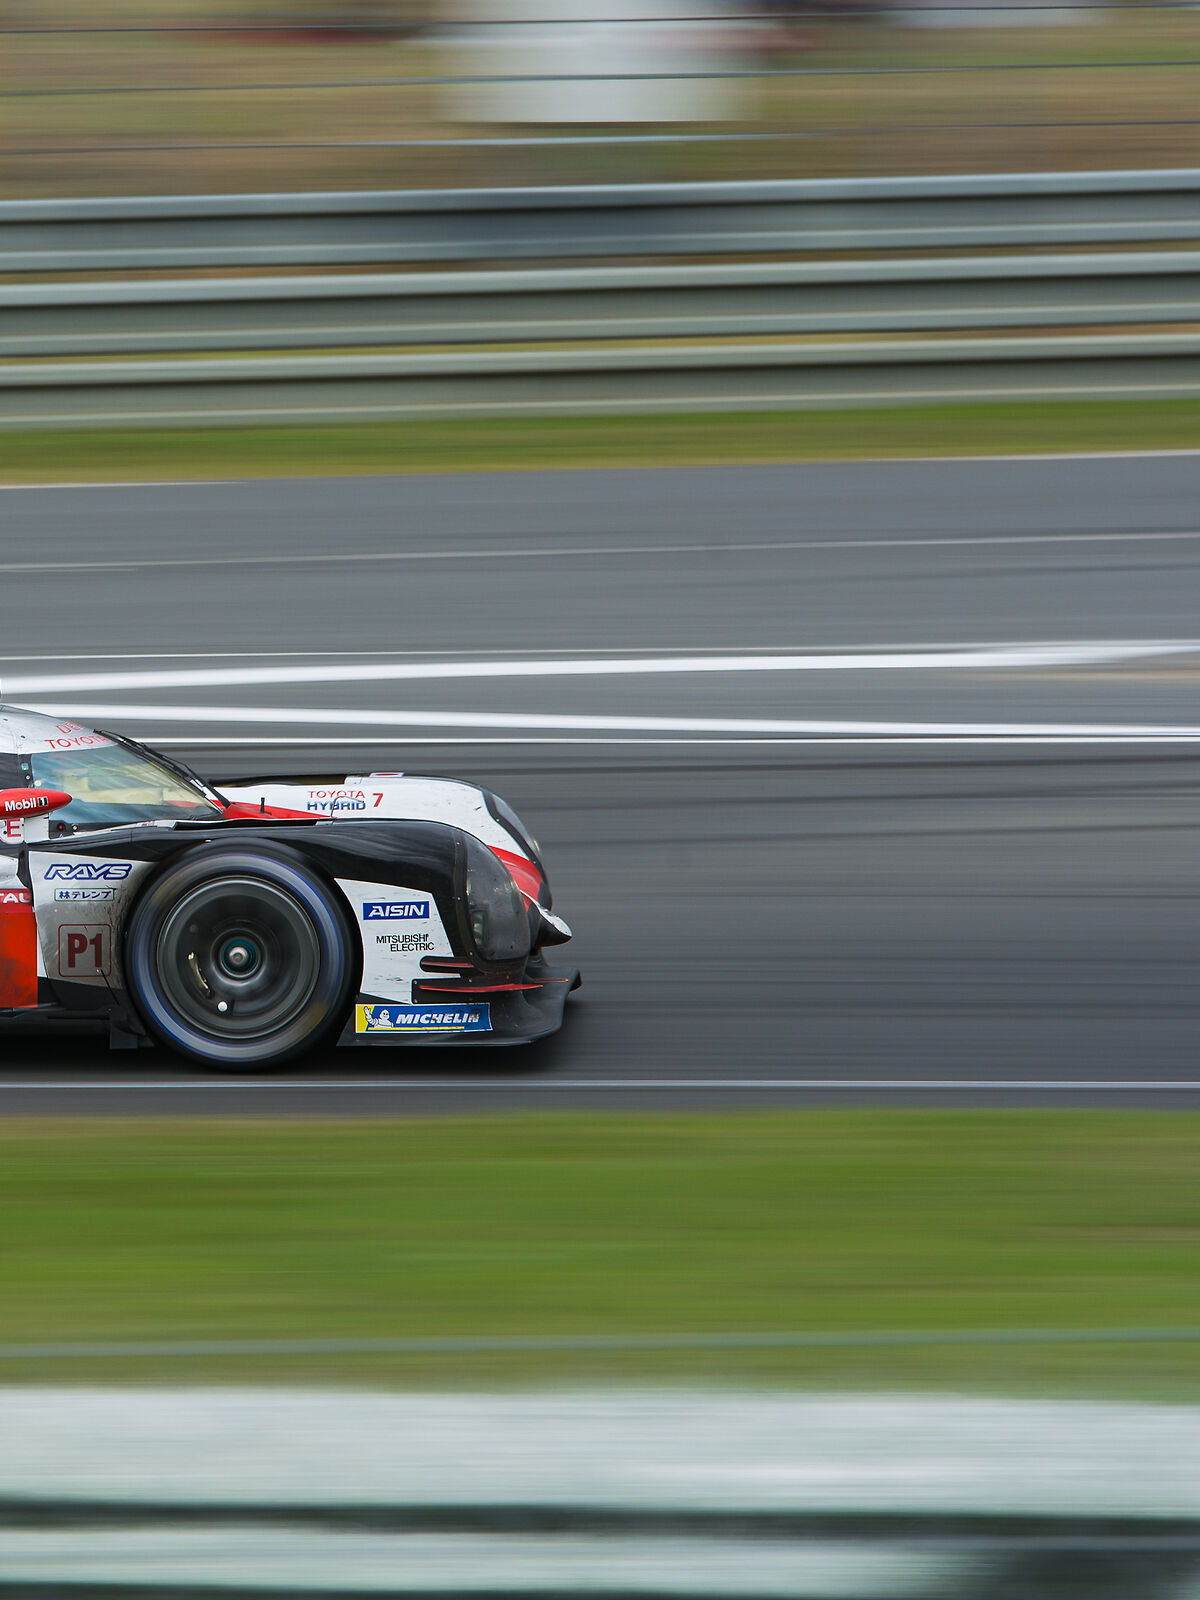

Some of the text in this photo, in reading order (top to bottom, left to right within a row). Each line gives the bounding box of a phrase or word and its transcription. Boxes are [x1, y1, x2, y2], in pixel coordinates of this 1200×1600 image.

[4, 797, 48, 812] Mobil 1
[307, 801, 366, 811] HYBRID
[372, 793, 384, 807] 7
[44, 863, 133, 880] RAYS
[58, 890, 112, 899] 林テレンプ
[368, 904, 425, 917] AISIN
[376, 933, 429, 943] MITSUBISHI
[67, 933, 103, 968] P1
[390, 942, 435, 952] ELECTRIC
[395, 1012, 480, 1025] MICHELIN
